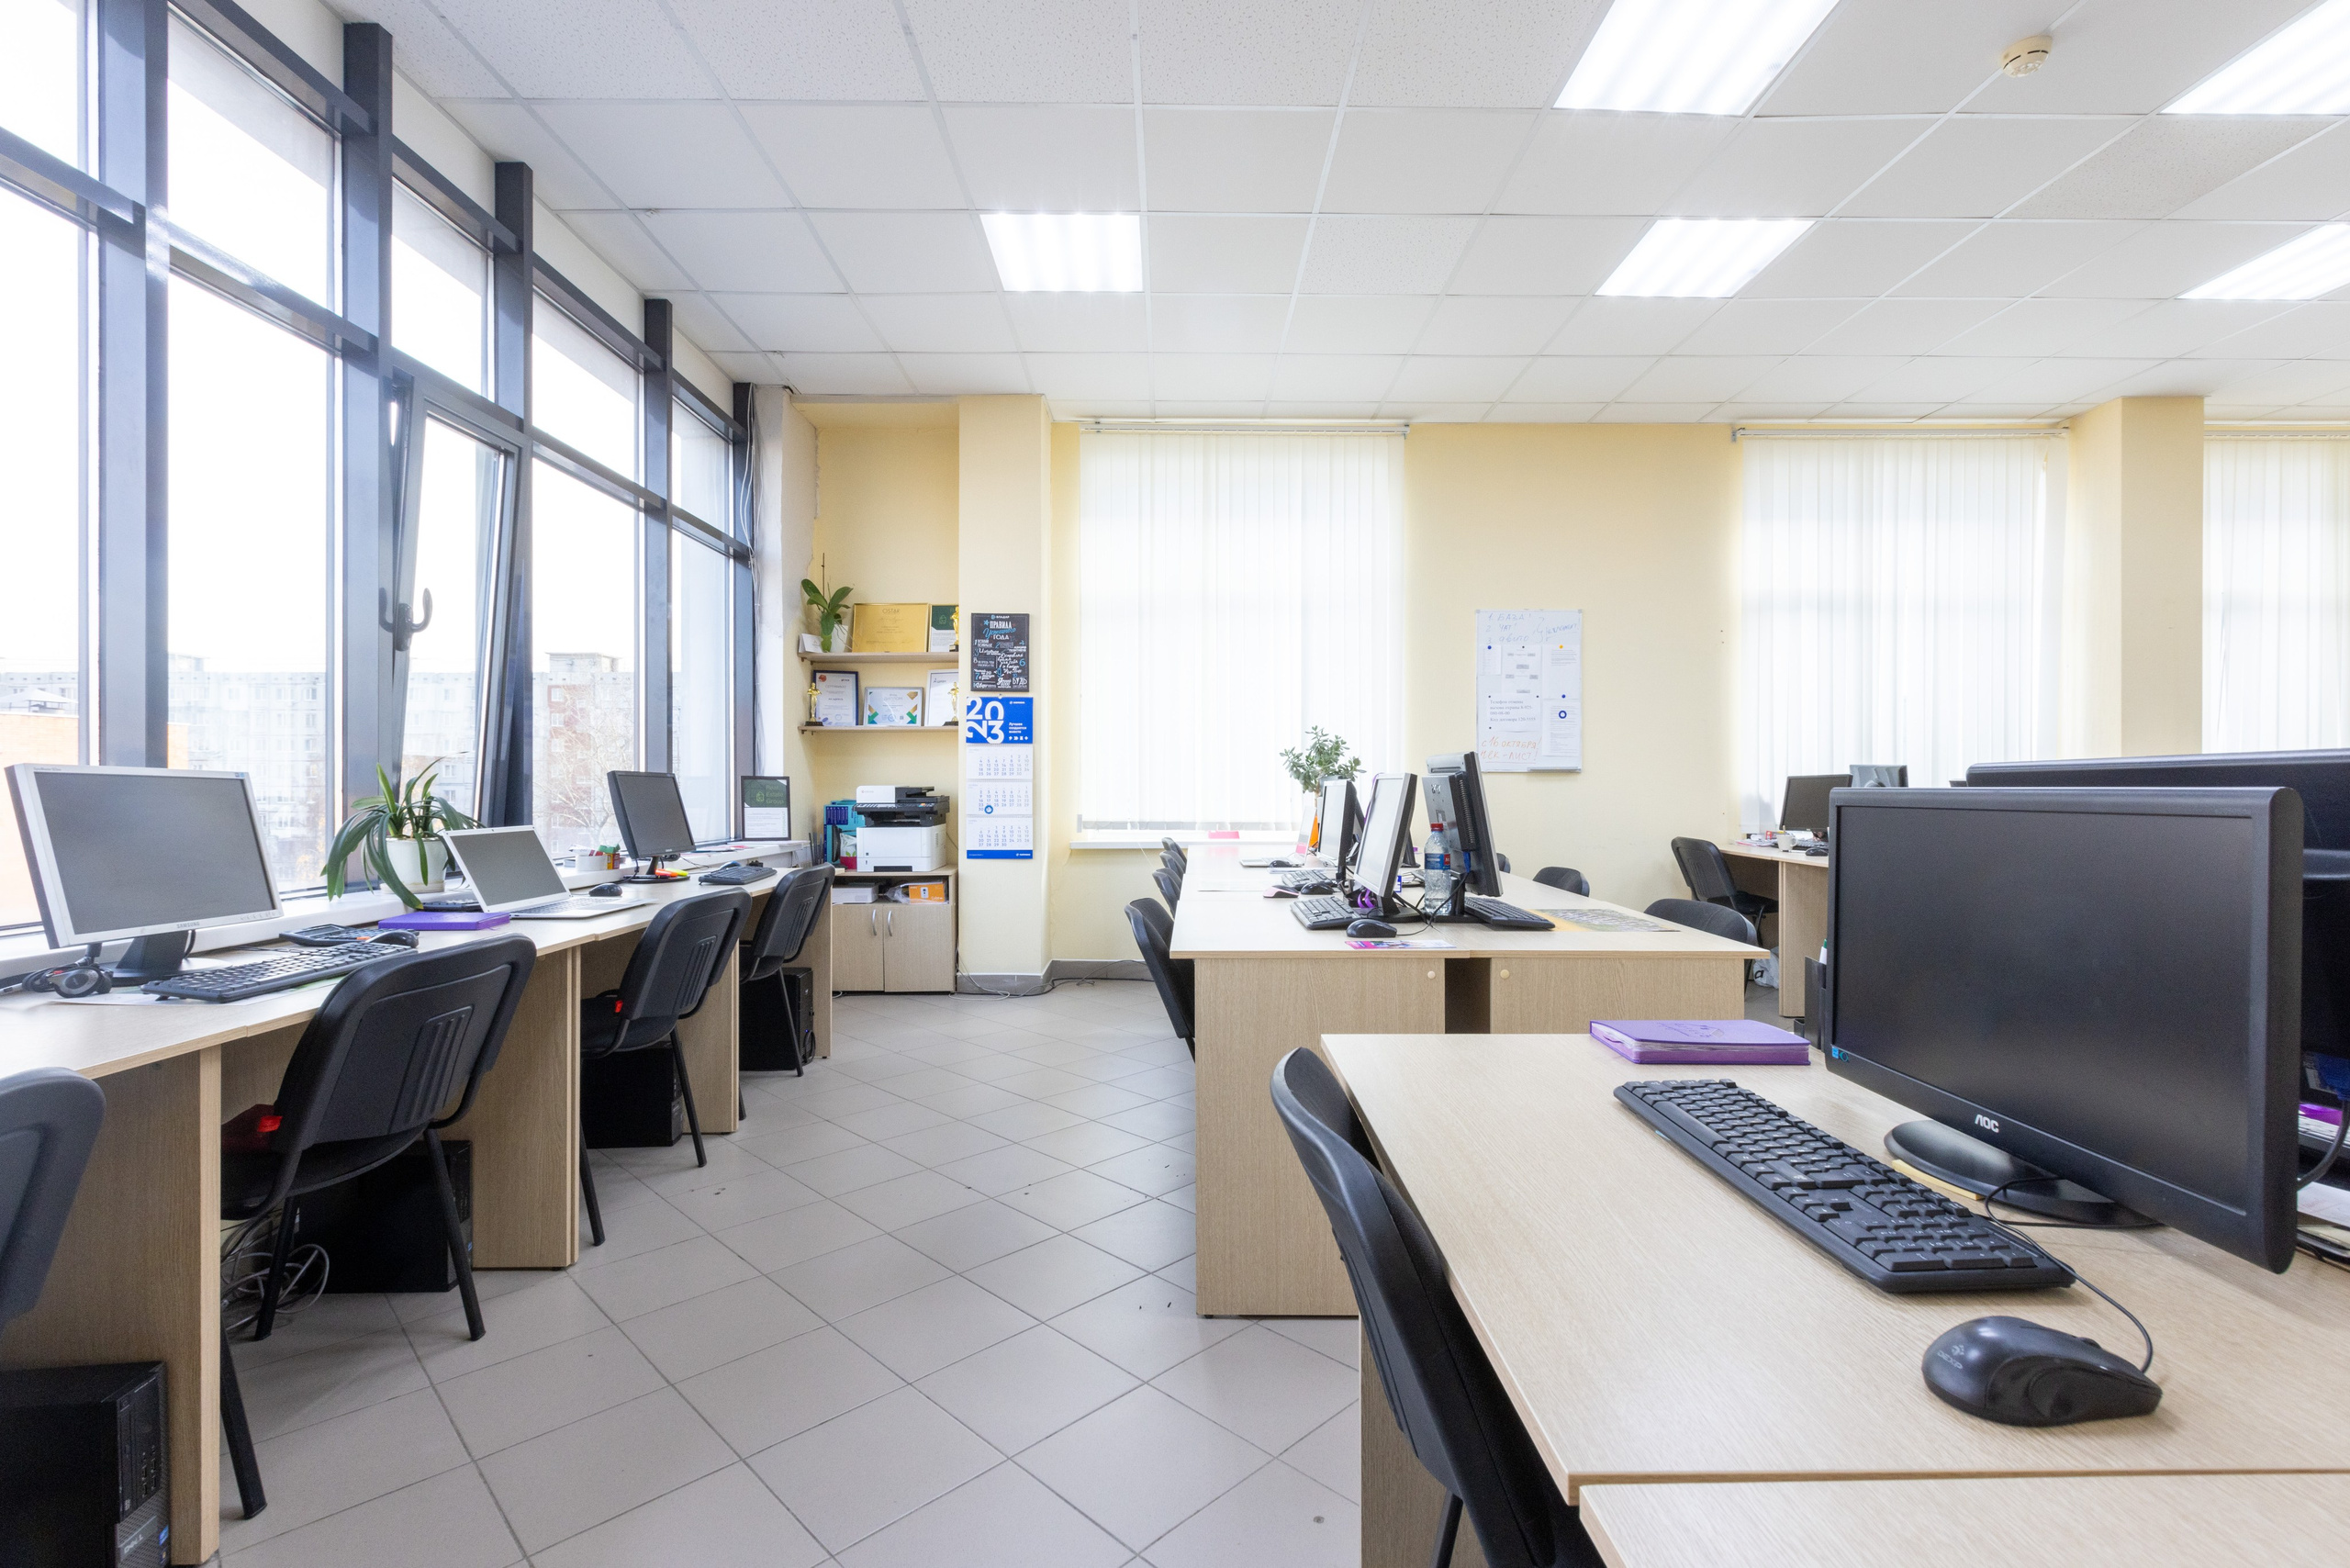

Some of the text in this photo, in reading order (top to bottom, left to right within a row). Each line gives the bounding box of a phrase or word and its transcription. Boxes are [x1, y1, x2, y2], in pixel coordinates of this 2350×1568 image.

[990, 621, 1013, 629] ПРАВИЛА
[1019, 658, 1026, 666] 6
[967, 697, 1004, 720] 20
[1975, 1114, 1999, 1133] AOC
[1937, 1350, 1964, 1369] DEXP
